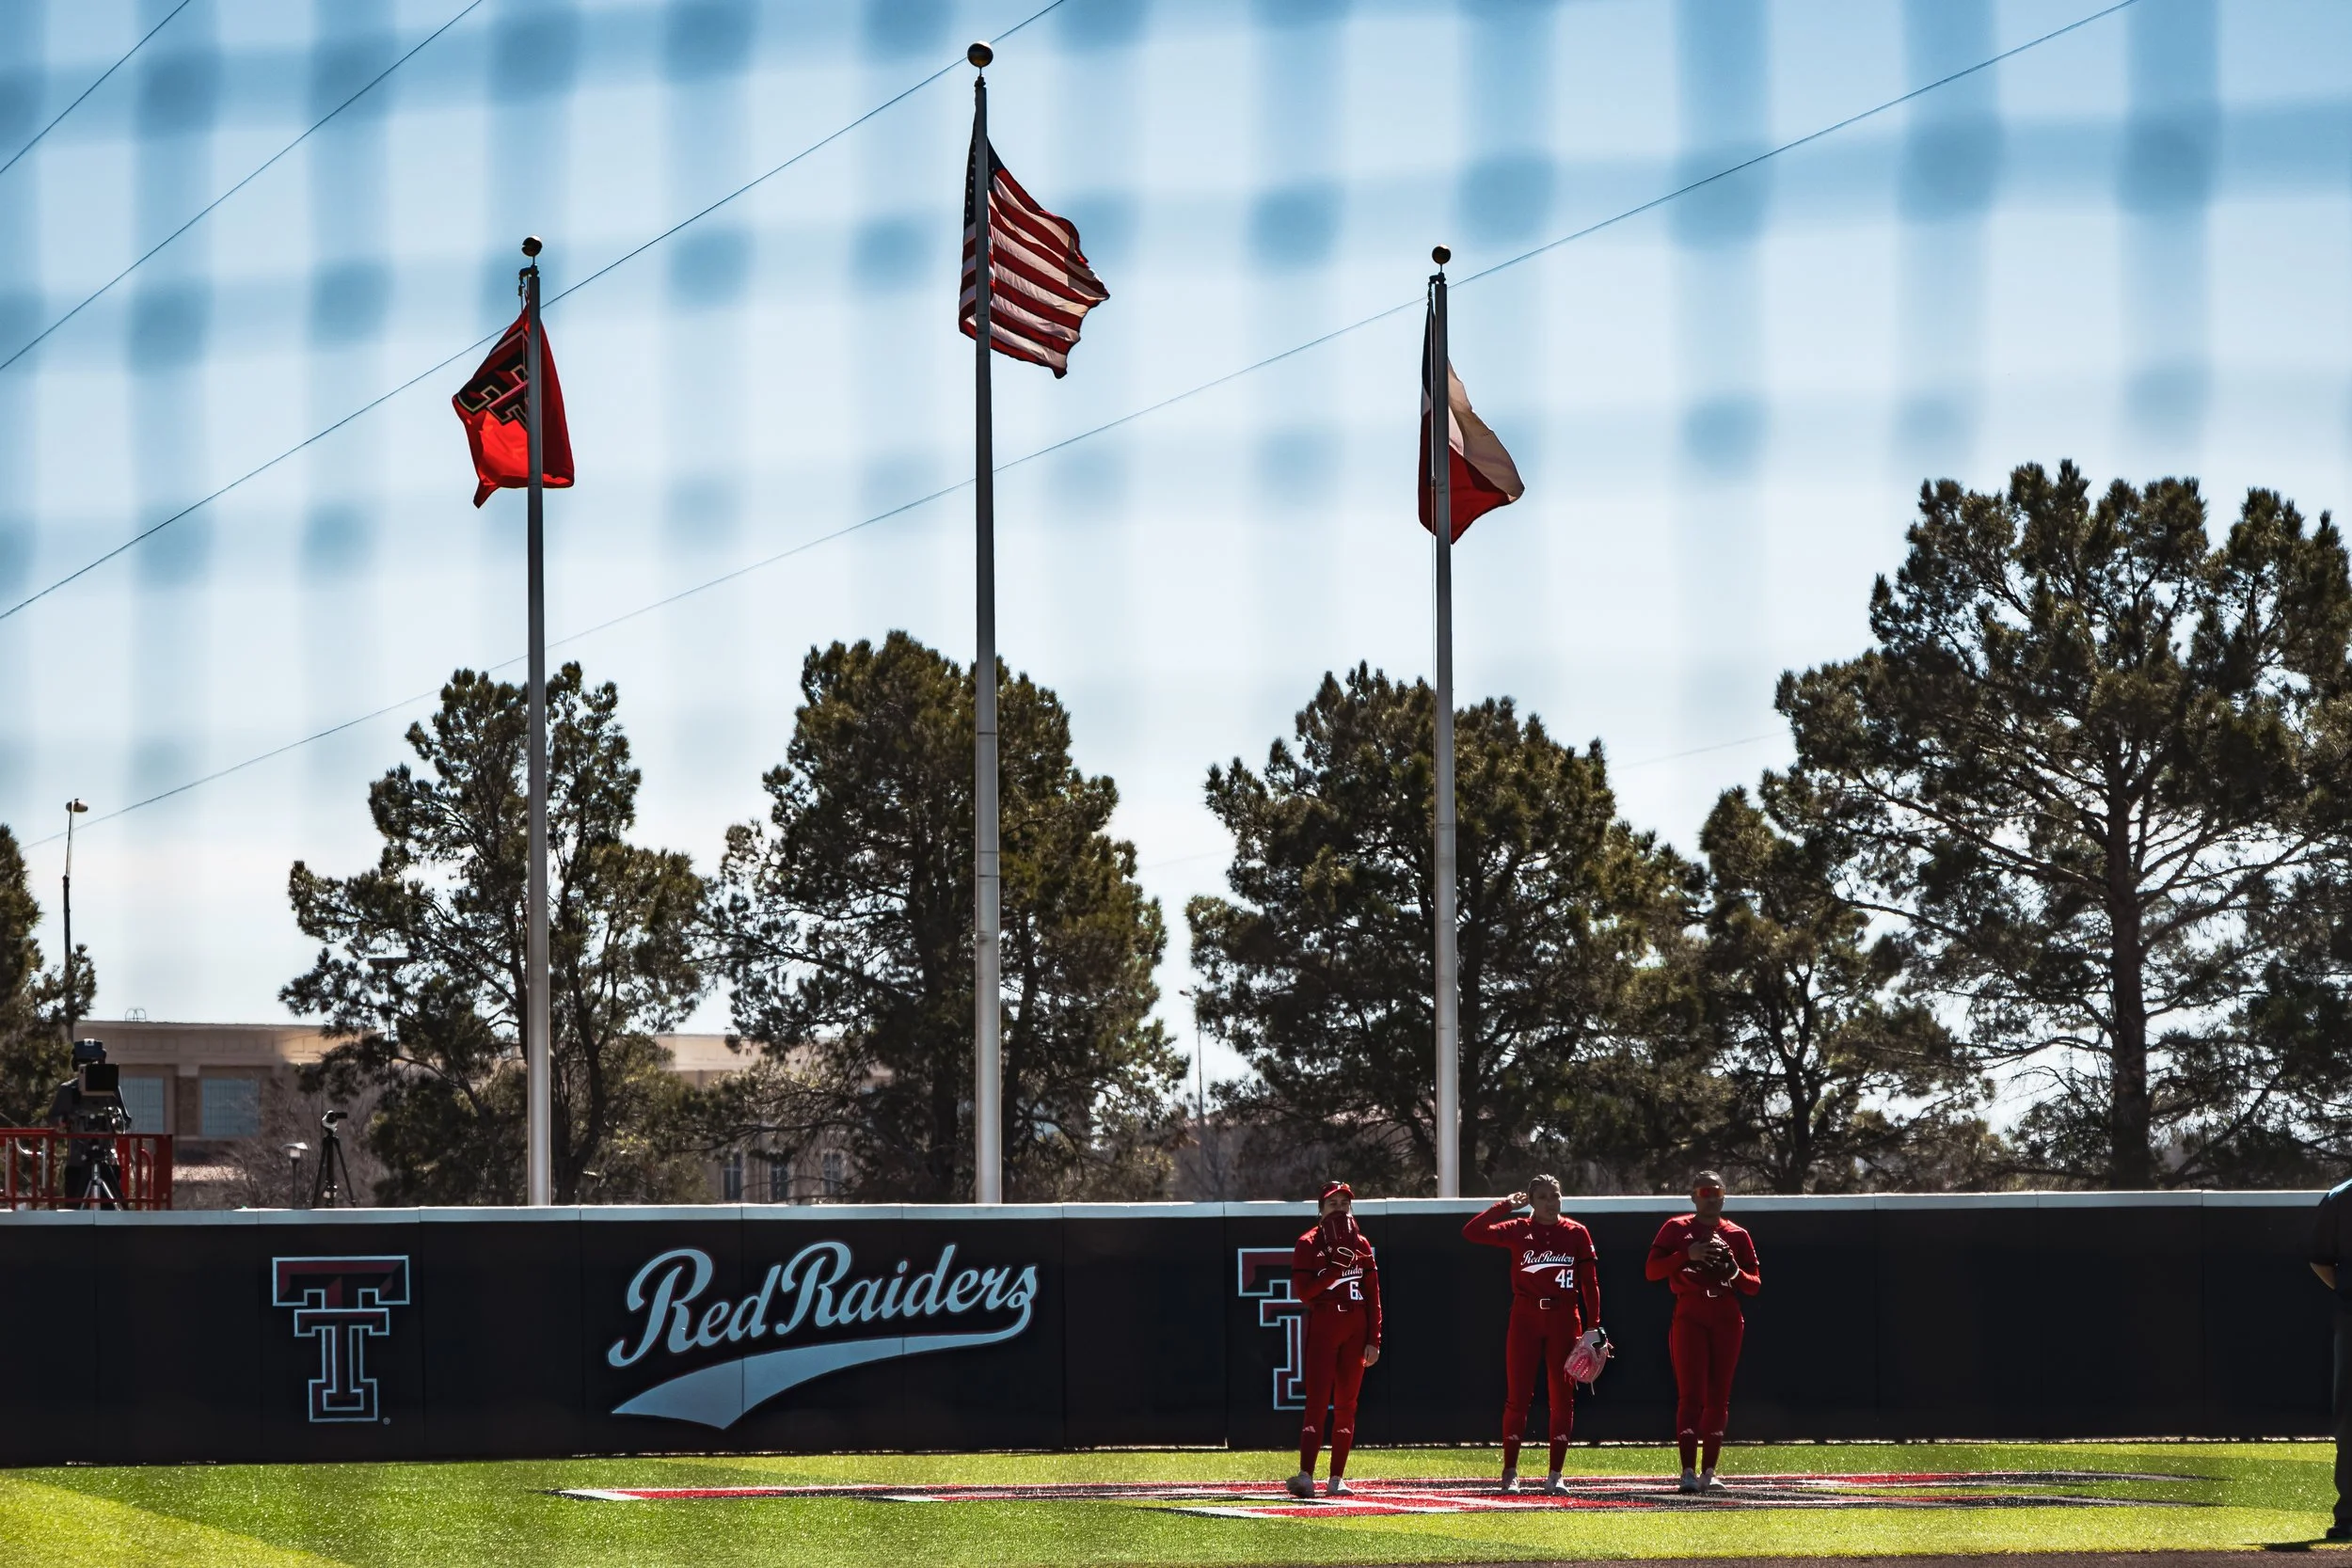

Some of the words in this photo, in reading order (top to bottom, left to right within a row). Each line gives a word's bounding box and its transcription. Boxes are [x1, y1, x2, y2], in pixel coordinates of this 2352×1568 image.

[1520, 1249, 1544, 1266] Red
[1541, 1250, 1575, 1264] Raiders
[1554, 1269, 1574, 1289] 42
[607, 1247, 782, 1368] Red
[774, 1241, 1039, 1336] Raiders
